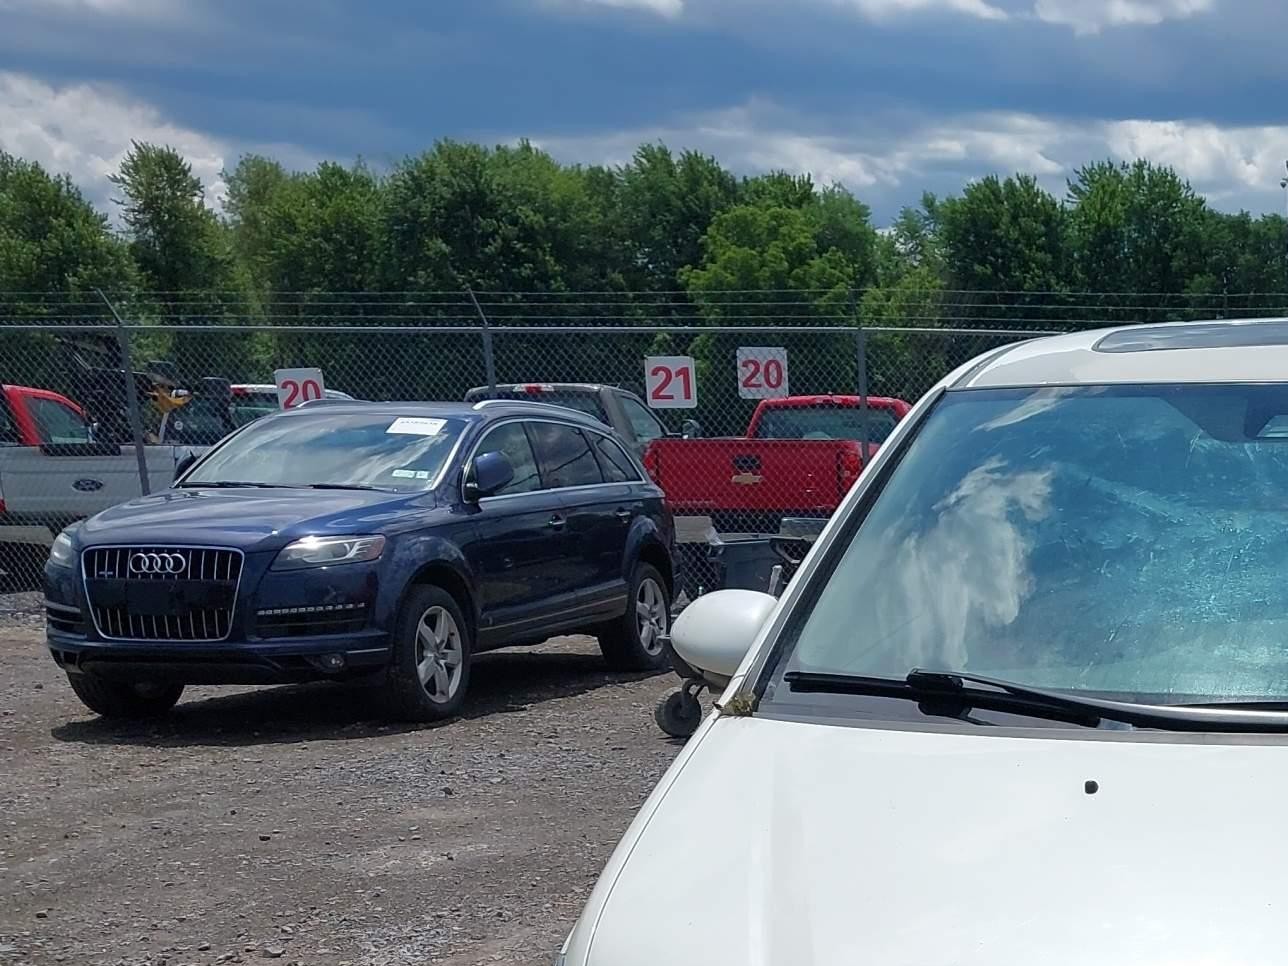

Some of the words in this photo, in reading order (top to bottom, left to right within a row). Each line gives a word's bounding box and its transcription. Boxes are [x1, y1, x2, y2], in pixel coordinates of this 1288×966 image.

[651, 365, 692, 400] 21
[742, 359, 783, 389] 20
[281, 379, 321, 409] 20
